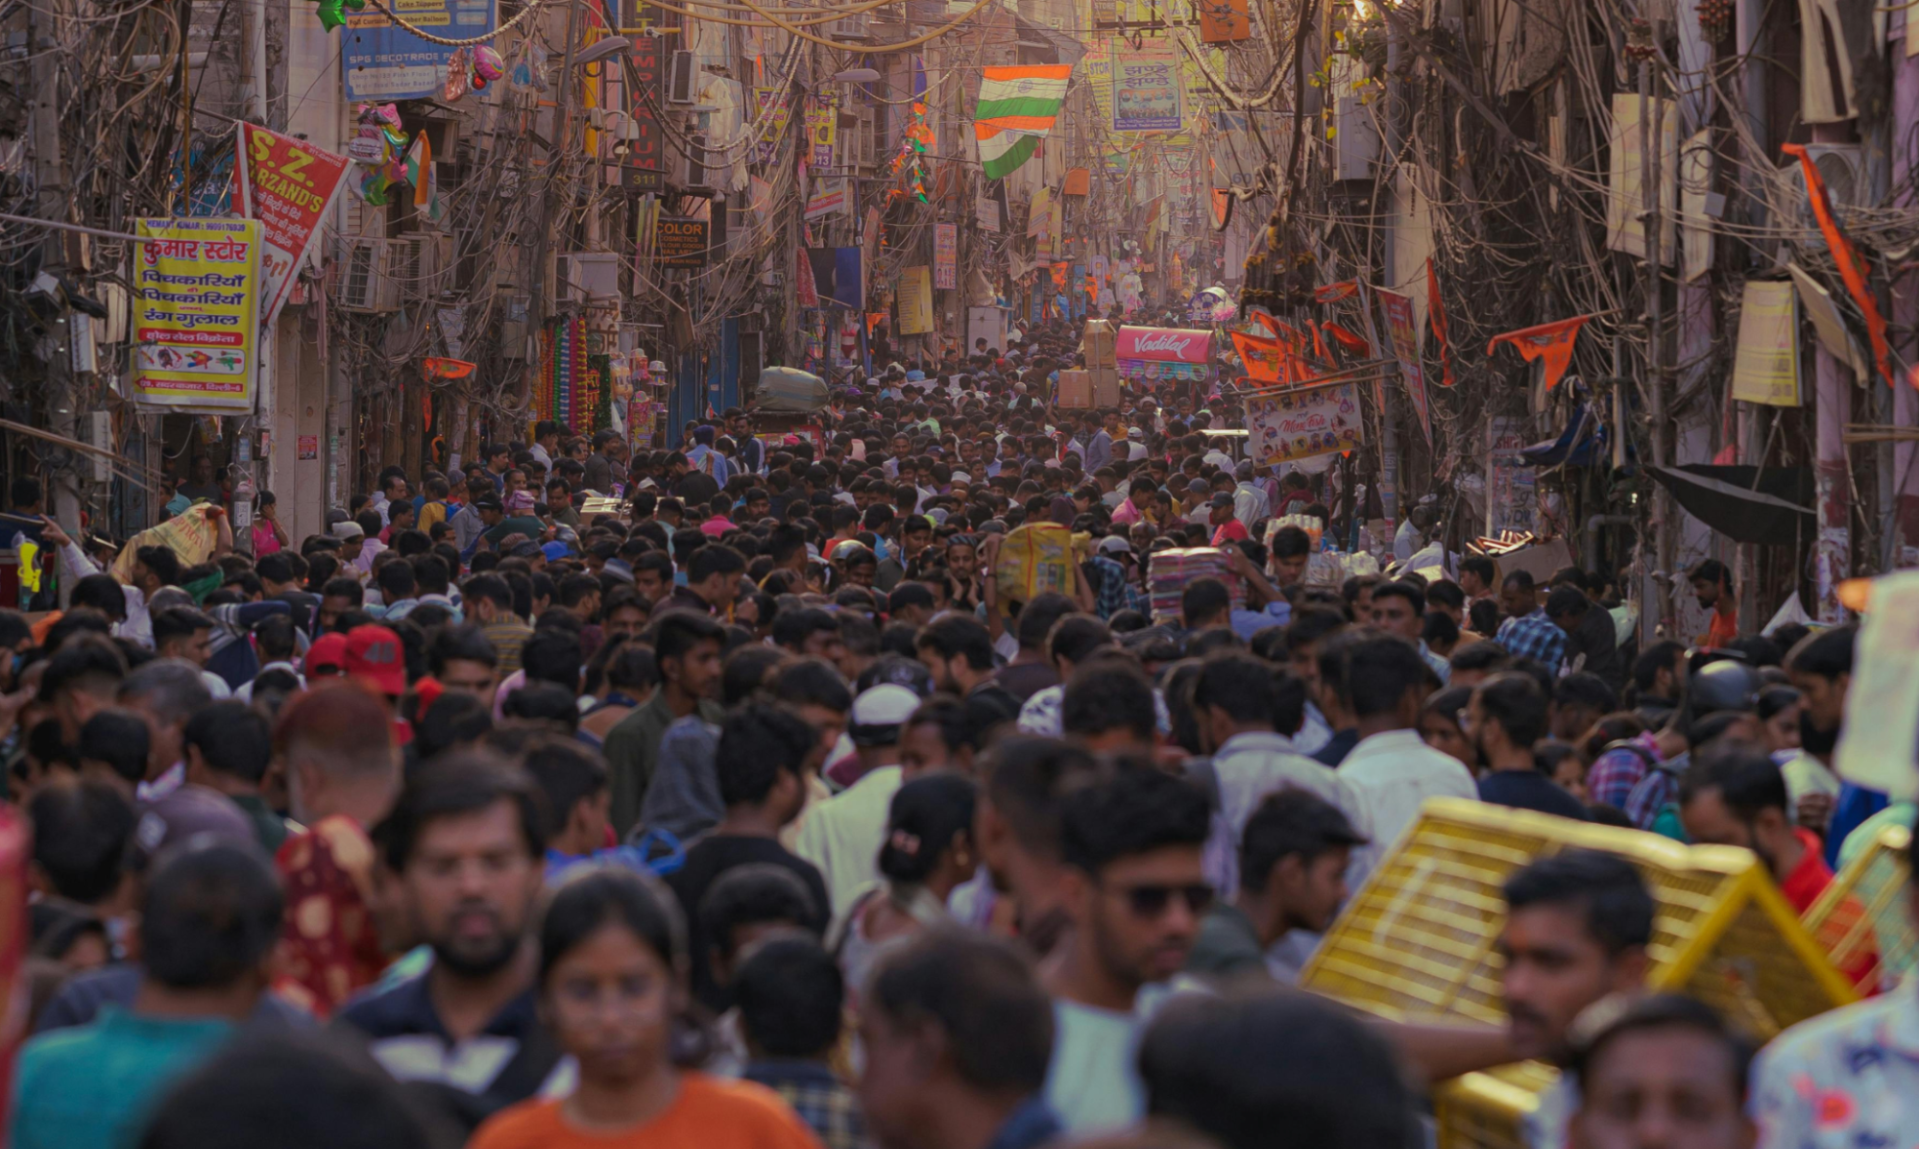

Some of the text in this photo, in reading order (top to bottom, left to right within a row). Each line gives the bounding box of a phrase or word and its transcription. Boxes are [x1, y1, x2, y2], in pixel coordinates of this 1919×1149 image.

[349, 55, 372, 64] SPG
[375, 52, 439, 62] DECOTRADE
[632, 38, 656, 170] EMPORIUM
[632, 174, 656, 185] 311
[1232, 172, 1252, 184] 60
[656, 222, 703, 236] COLOR
[144, 235, 249, 266] कुमार स्टोर
[142, 269, 247, 287] पिचकारियाँ
[142, 288, 246, 306] पिचकारियाँ
[144, 308, 241, 328] रंग गुलाल
[196, 332, 237, 344] विक्रेता
[1134, 332, 1191, 360] Vadilal
